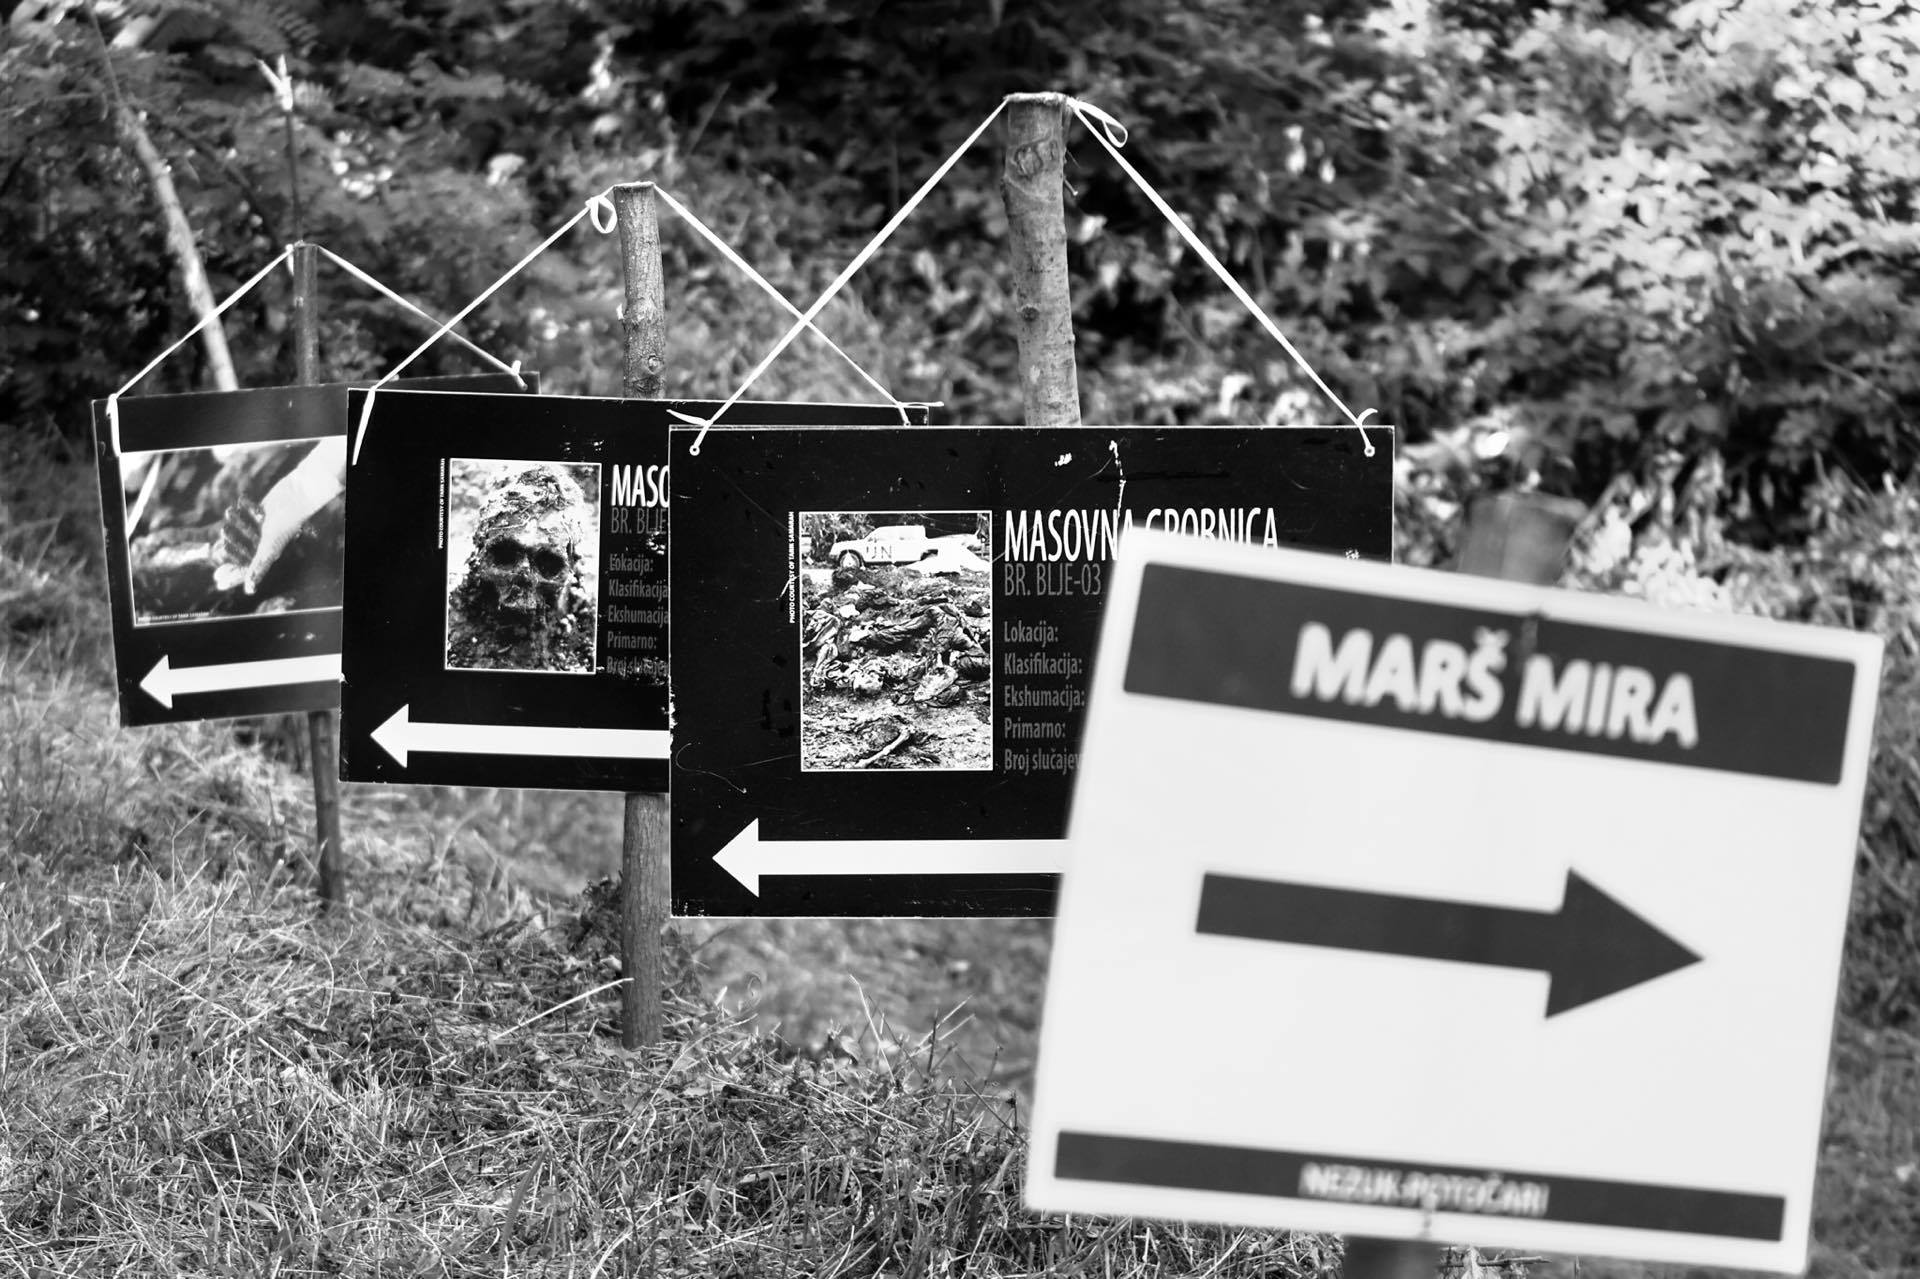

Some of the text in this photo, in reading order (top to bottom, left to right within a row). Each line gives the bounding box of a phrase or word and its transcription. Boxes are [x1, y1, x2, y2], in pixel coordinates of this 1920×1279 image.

[611, 507, 632, 534] BR.
[788, 561, 795, 570] OF
[1004, 562, 1101, 596] BR. BLJE-03
[607, 630, 657, 649] Primarno:
[1004, 619, 1059, 648] Lokacija:
[1004, 652, 1083, 679] Klasifikacija:
[1291, 620, 1699, 749] MARŠ MIRA
[1004, 685, 1085, 712] Ekshumacija:
[1004, 716, 1066, 739] Primarno:
[1004, 747, 1030, 776] Broj
